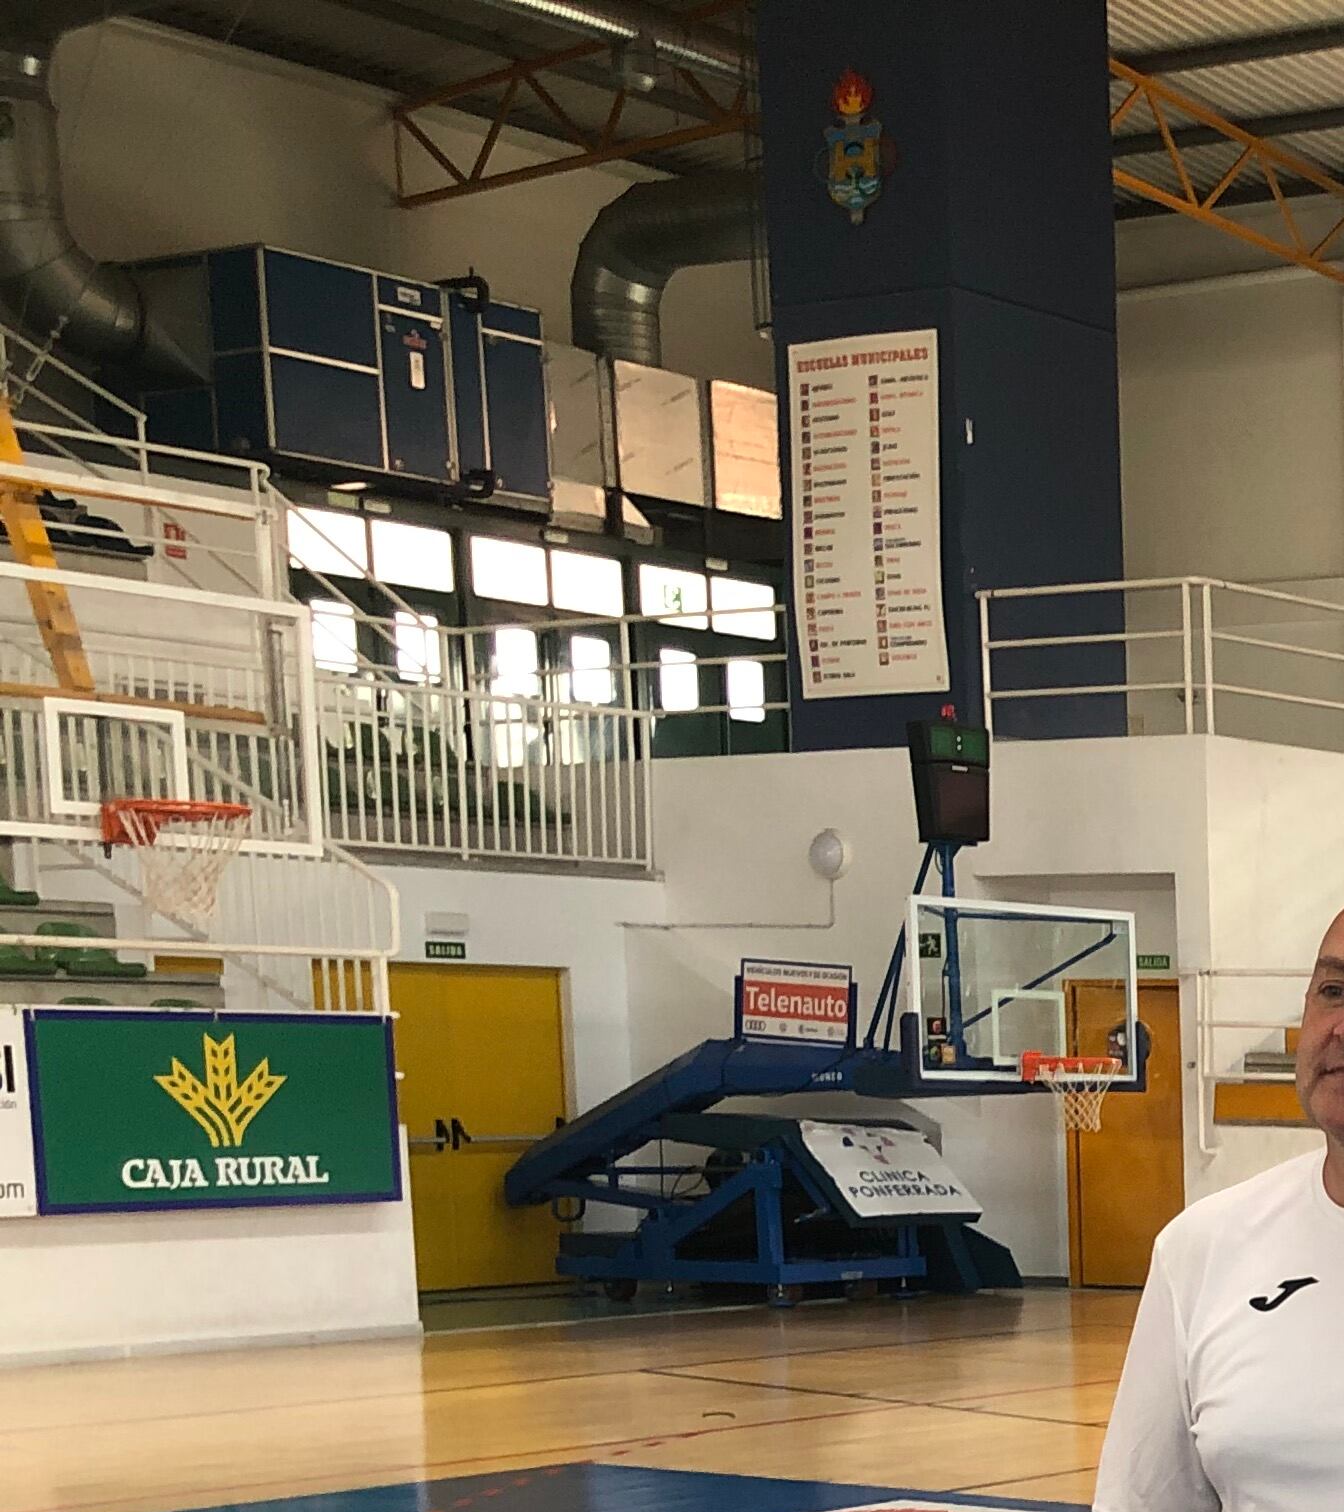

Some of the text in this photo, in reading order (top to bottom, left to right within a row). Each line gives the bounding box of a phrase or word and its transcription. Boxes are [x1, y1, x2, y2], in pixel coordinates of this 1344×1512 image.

[429, 944, 462, 956] SALIDA
[1139, 956, 1168, 967] SALIDA
[745, 986, 847, 1018] Telenauto
[121, 1155, 330, 1190] CAJA RURAL
[848, 1183, 962, 1199] PONFERRADA
